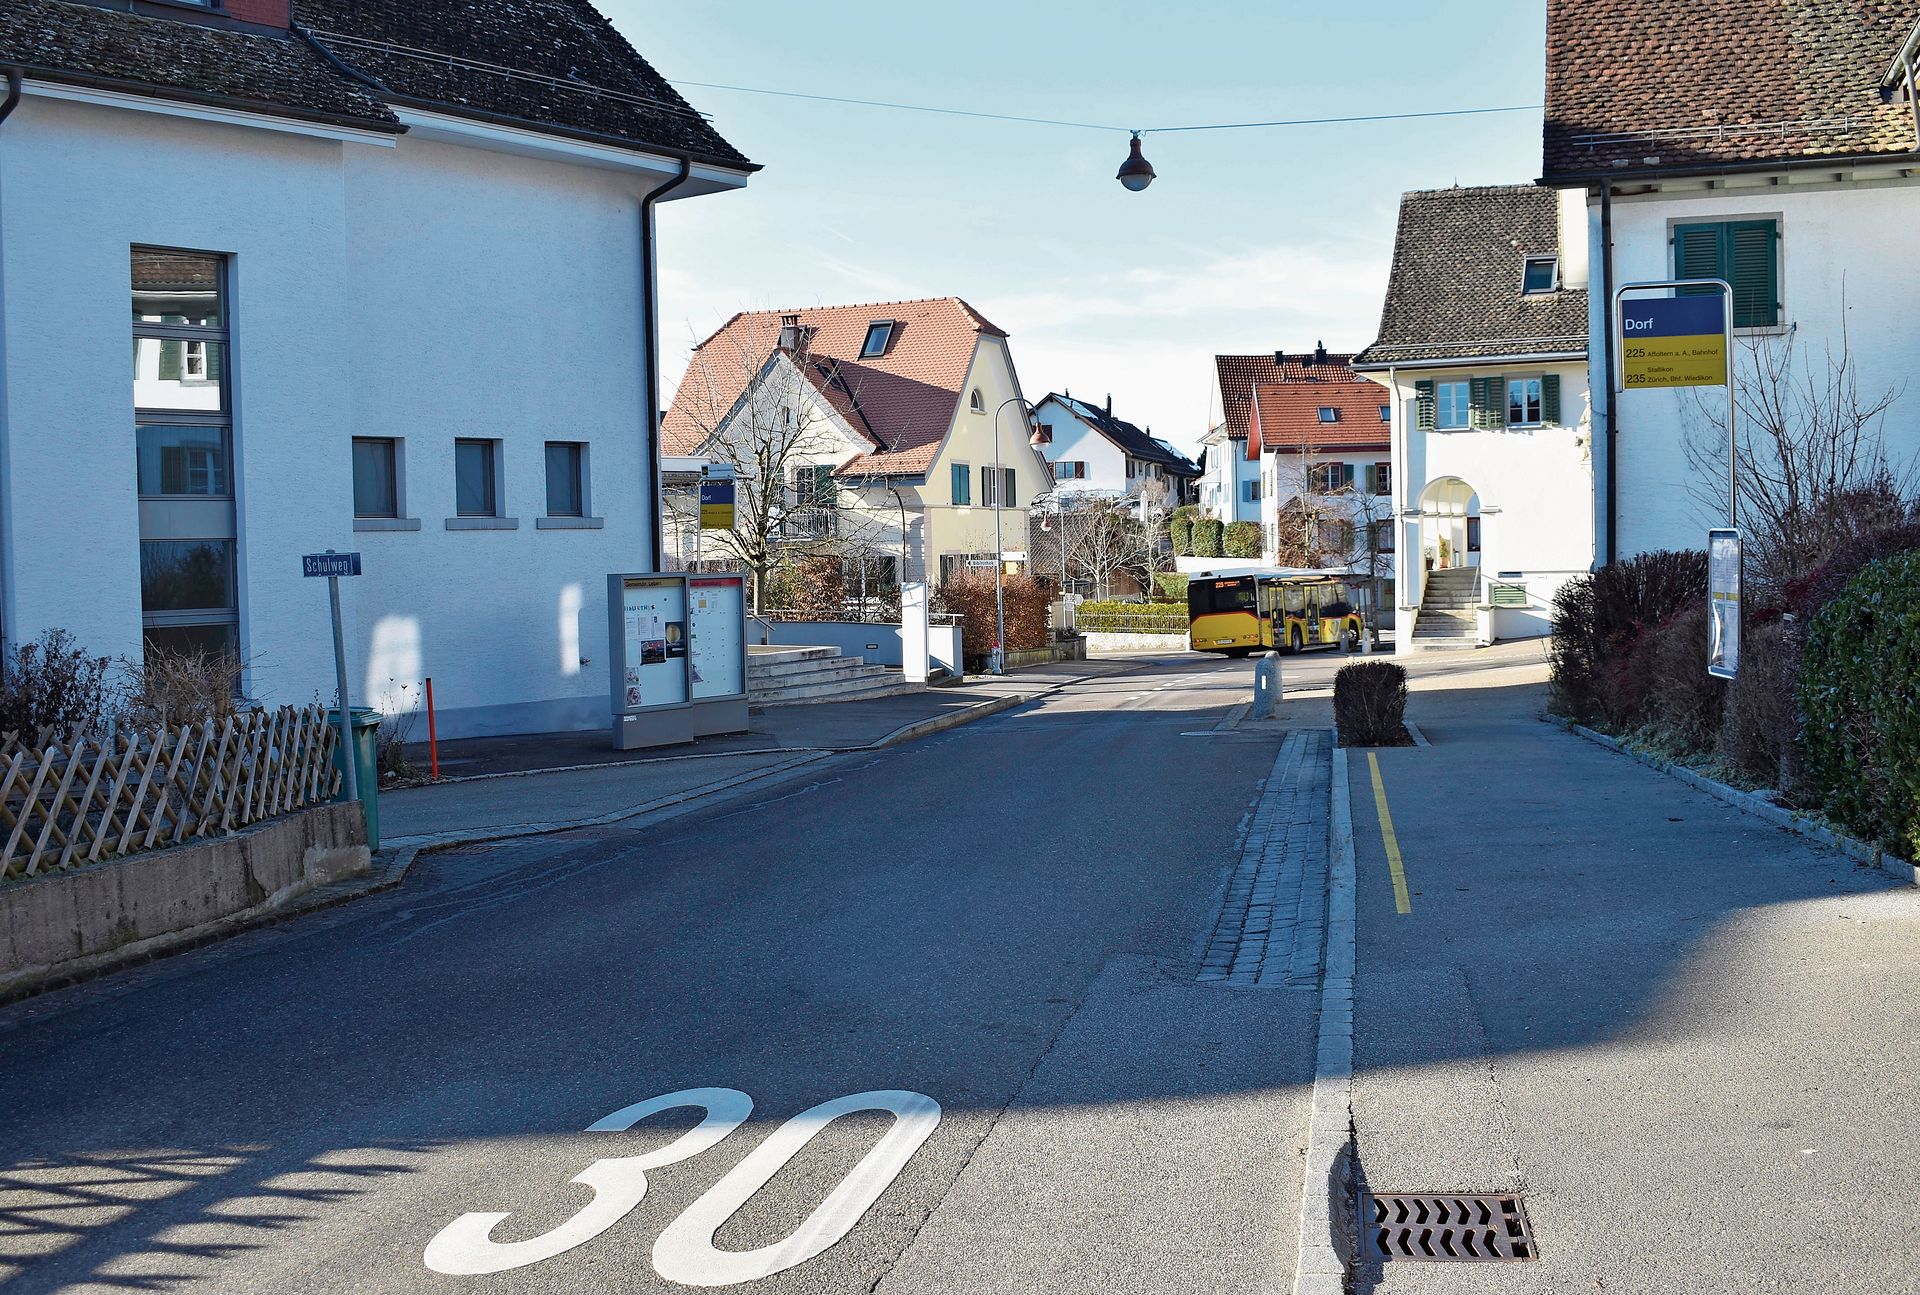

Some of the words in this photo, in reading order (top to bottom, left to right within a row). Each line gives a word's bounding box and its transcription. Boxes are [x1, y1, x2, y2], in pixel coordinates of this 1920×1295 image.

[1625, 318, 1653, 330] Dorf
[1626, 348, 1645, 358] 225
[1692, 348, 1718, 356] Bahnhof
[1626, 374, 1645, 383] 235
[306, 558, 349, 575] Schulweg
[424, 1087, 941, 1286] 30
